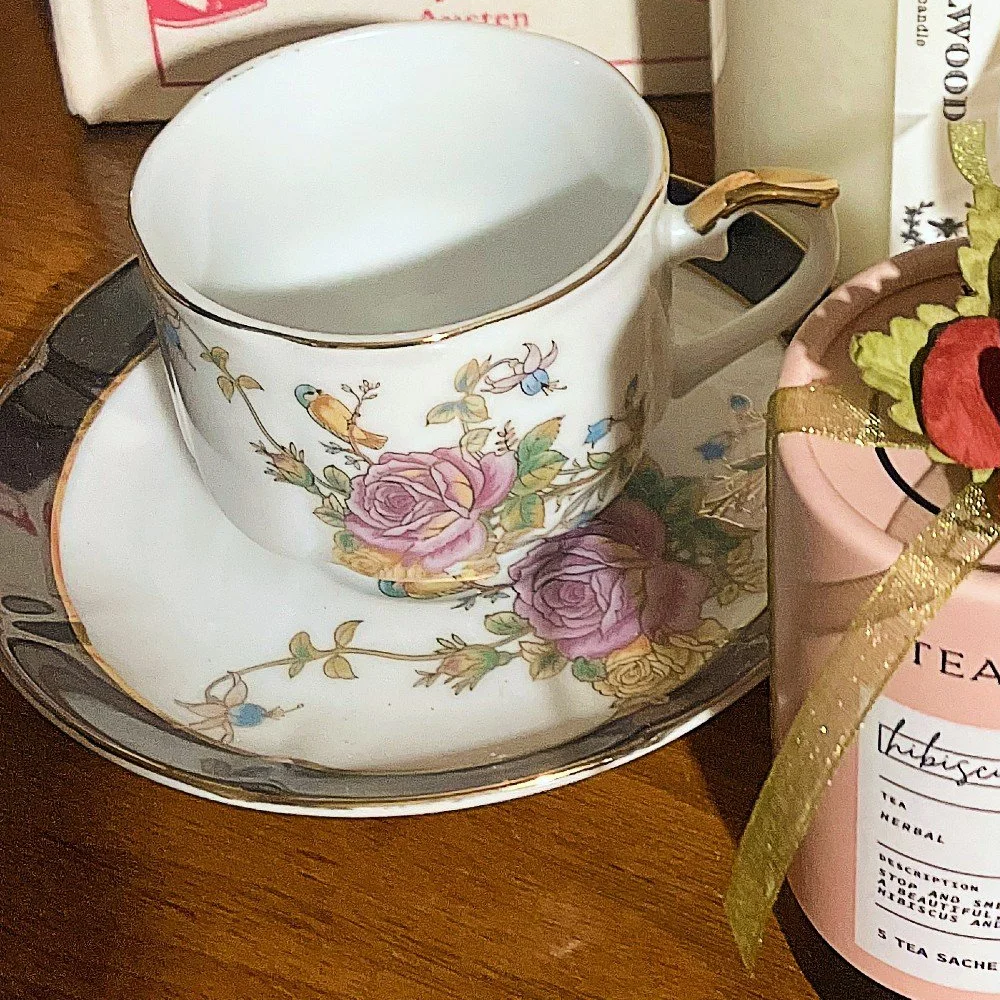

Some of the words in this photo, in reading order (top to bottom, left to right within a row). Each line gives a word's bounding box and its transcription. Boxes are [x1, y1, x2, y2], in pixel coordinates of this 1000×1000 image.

[880, 791, 907, 810] TEA
[880, 811, 945, 844] HERBAL
[877, 878, 887, 888] A
[878, 853, 980, 892] DESCRIPTION
[878, 868, 918, 889] STOP
[928, 890, 961, 904] AND
[876, 887, 958, 923] HIBISCUS
[877, 928, 888, 940] 5
[894, 936, 929, 959] TEA
